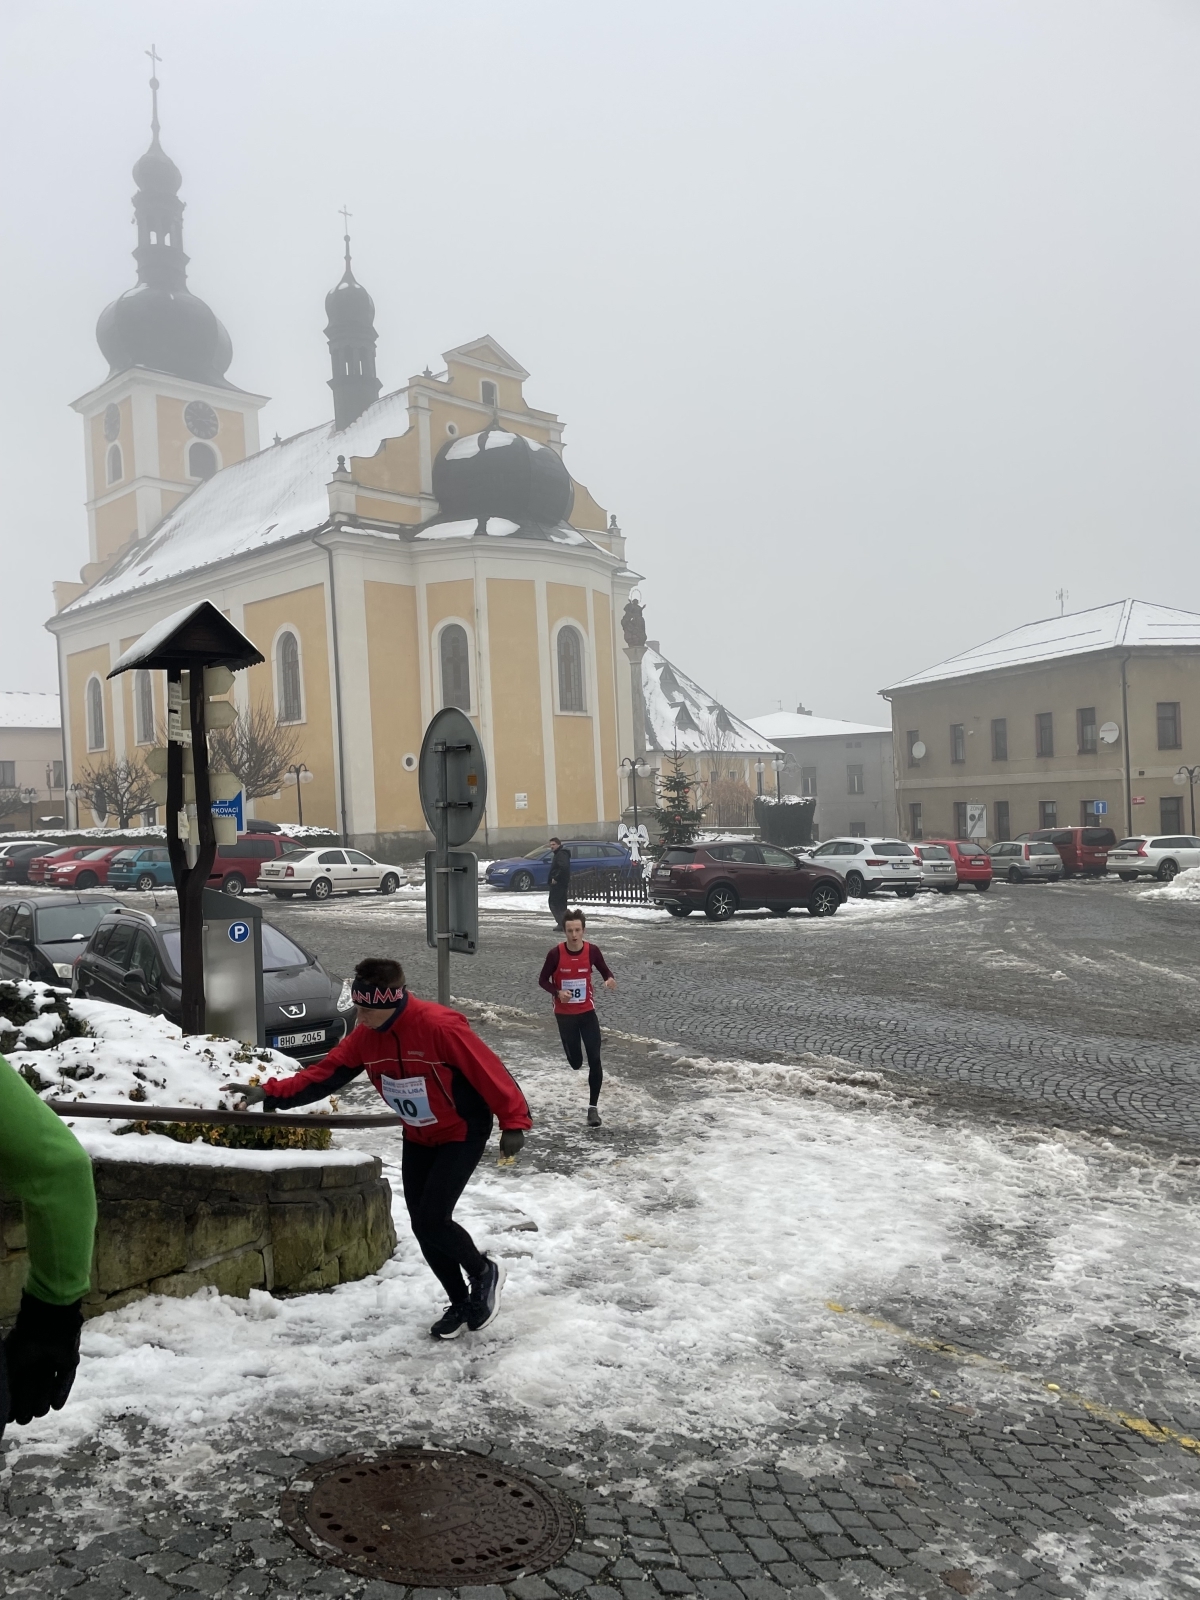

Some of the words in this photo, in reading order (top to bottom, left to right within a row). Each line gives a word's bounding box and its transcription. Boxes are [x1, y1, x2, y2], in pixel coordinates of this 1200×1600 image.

[235, 925, 245, 939] P
[302, 1032, 322, 1043] 2045
[393, 1098, 418, 1118] 10
